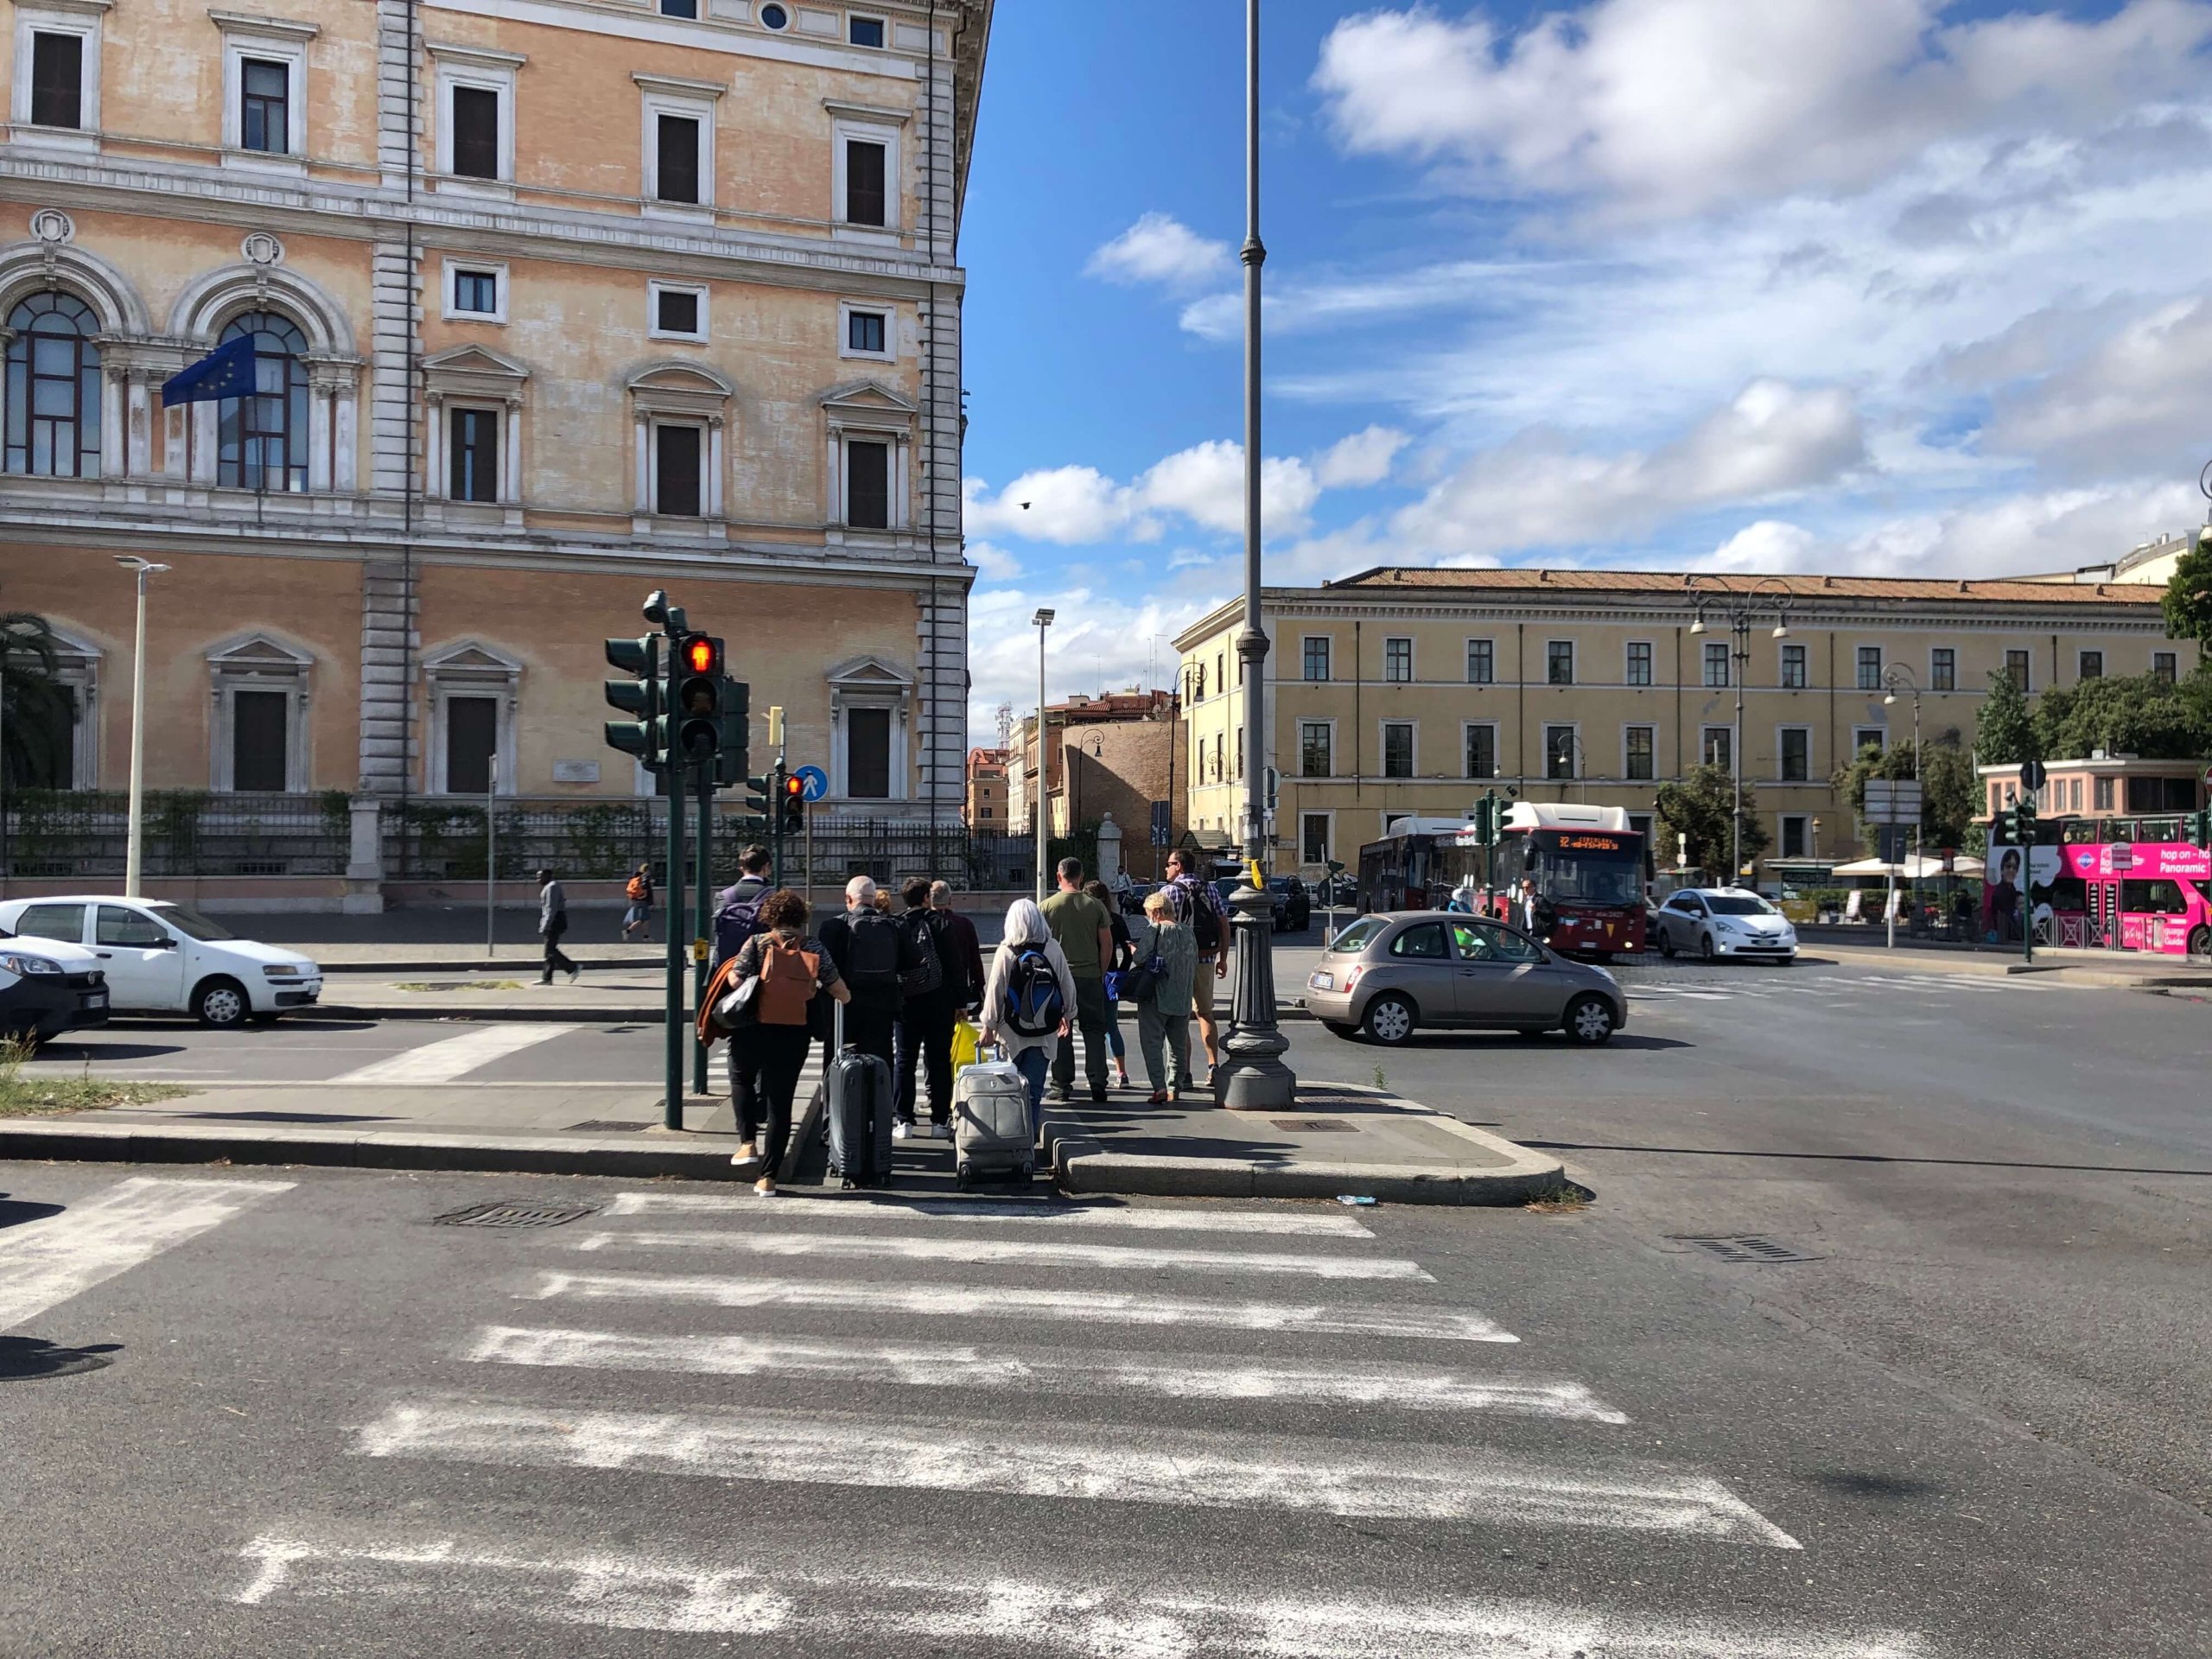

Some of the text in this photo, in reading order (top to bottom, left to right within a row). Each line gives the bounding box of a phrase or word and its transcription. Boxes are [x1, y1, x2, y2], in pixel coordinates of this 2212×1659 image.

[2160, 849, 2177, 861] hop
[2178, 850, 2190, 860] on
[2159, 862, 2206, 873] Panoramic
